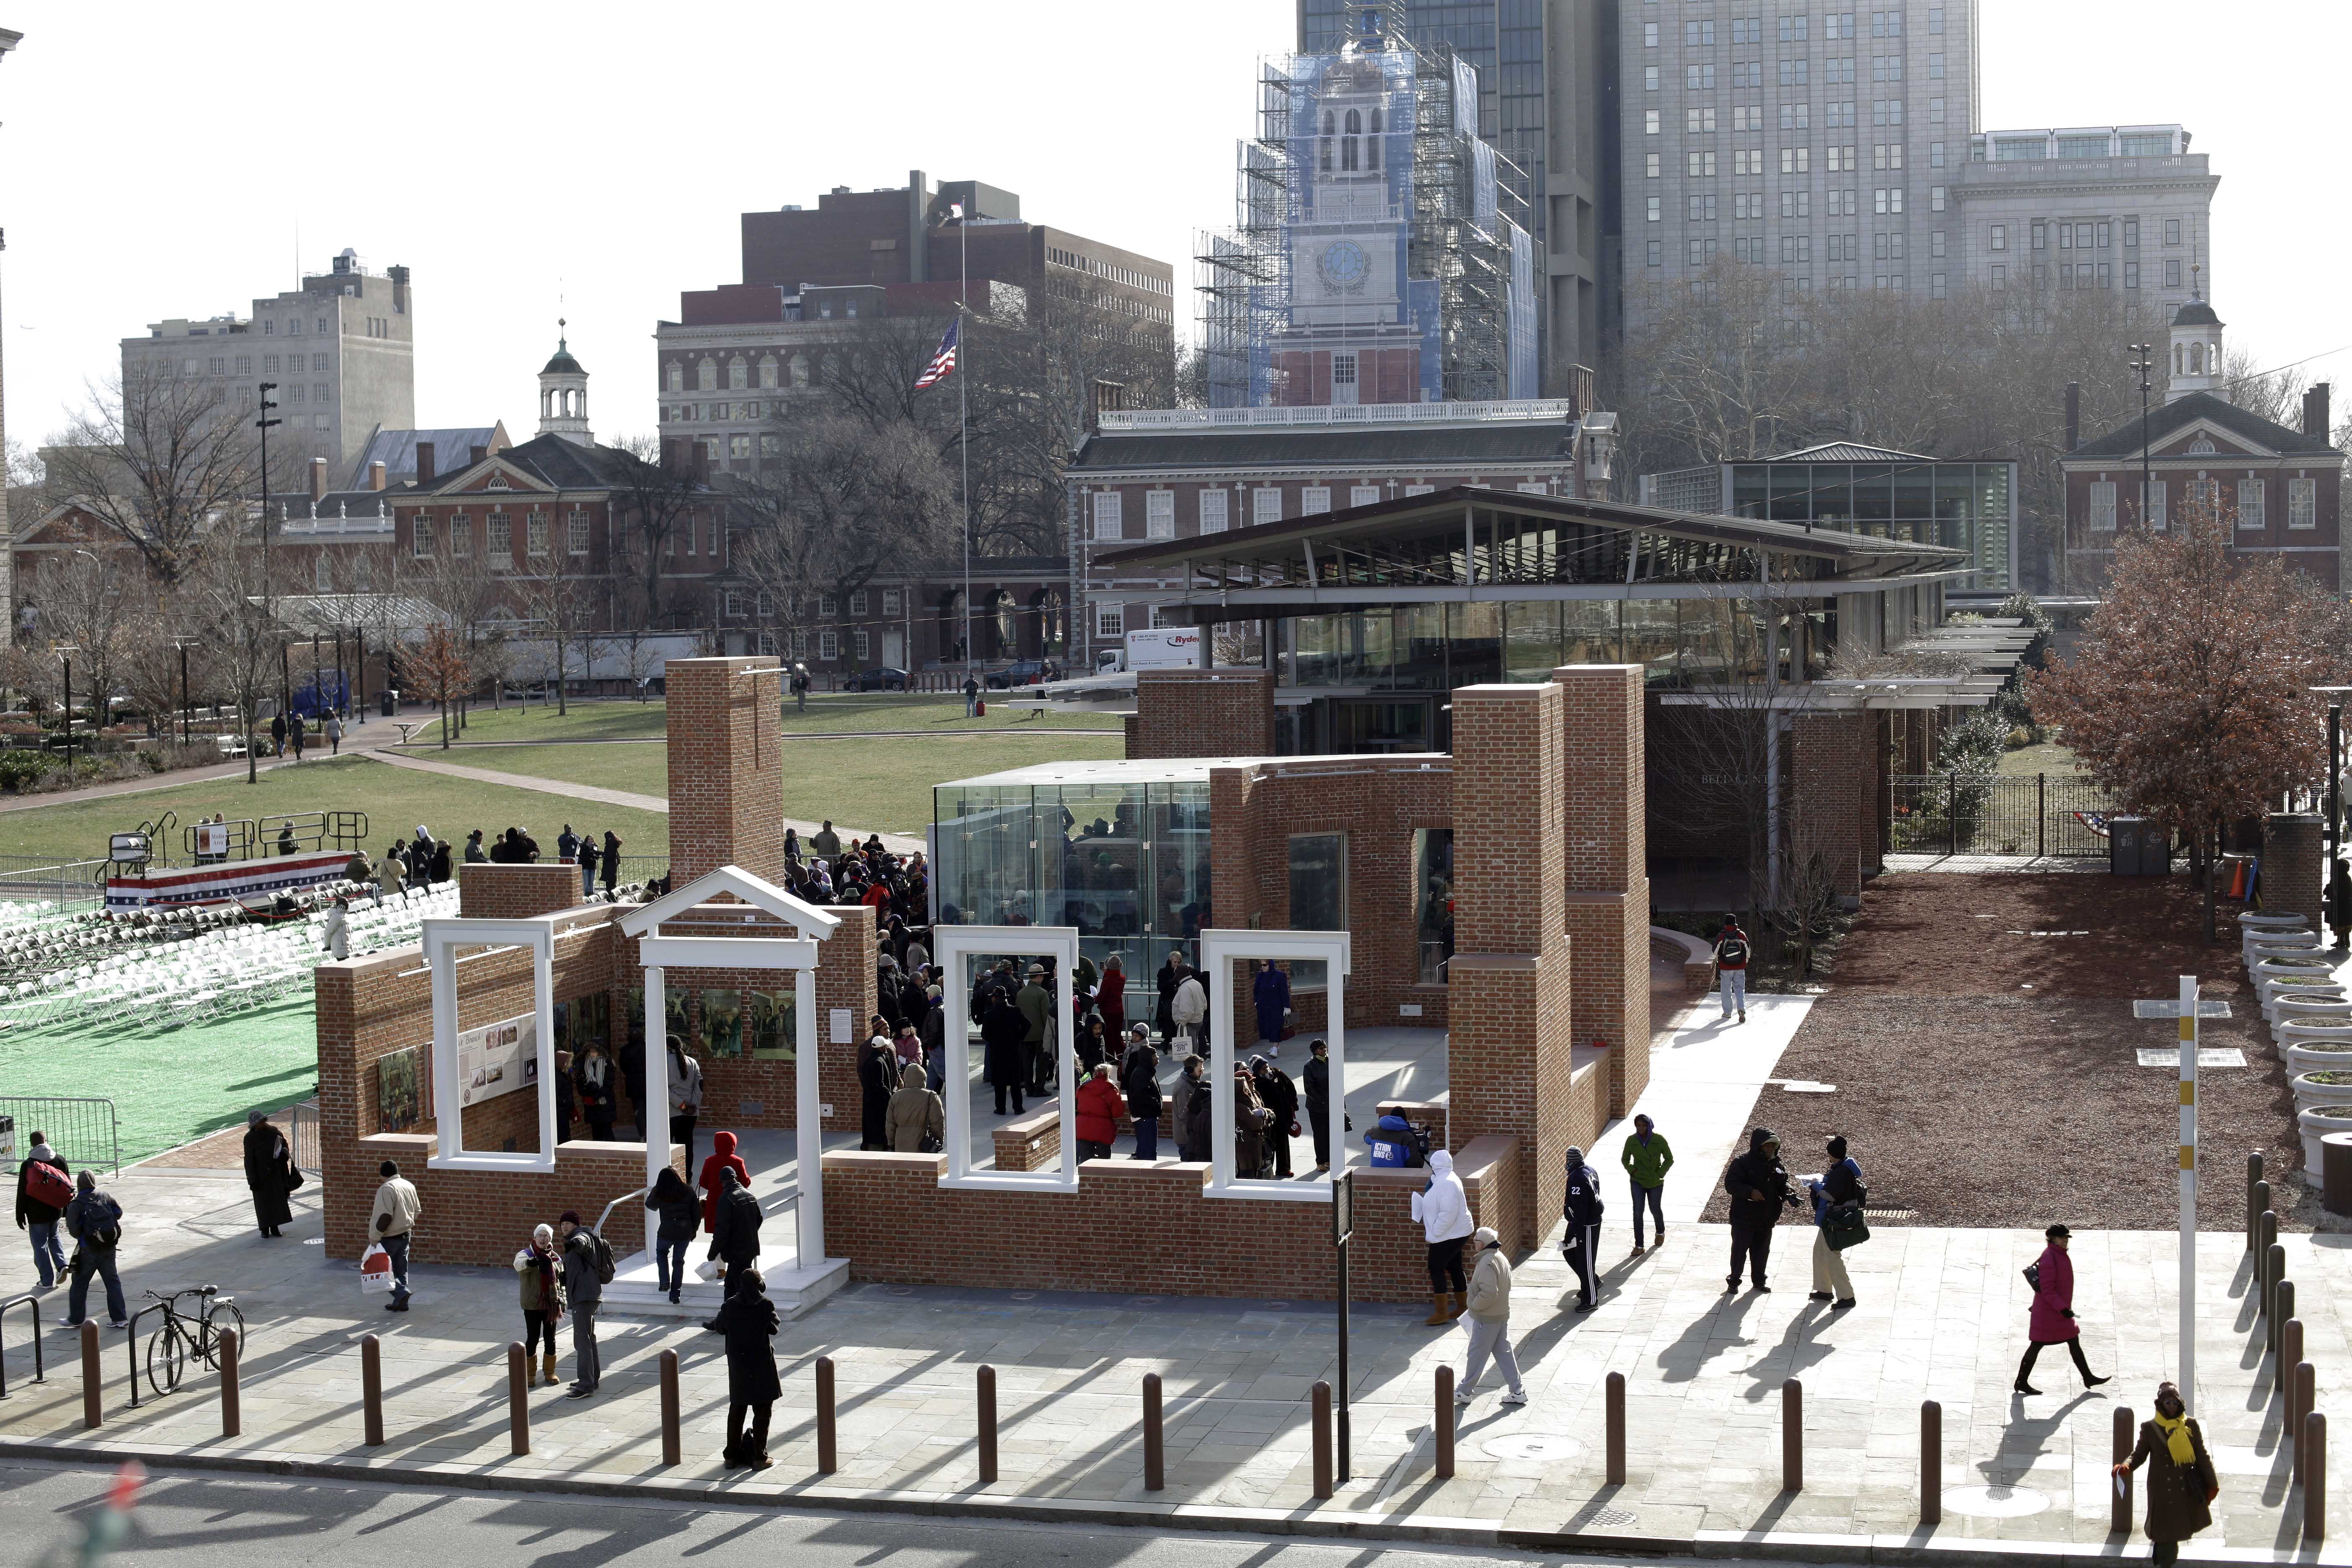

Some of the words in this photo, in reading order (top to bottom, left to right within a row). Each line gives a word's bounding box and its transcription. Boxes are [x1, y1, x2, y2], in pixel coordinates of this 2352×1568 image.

[1702, 774, 1730, 784] BELL
[1735, 774, 1787, 784] CENTR
[1374, 1142, 1391, 1152] ACTION
[1571, 1186, 1581, 1195] 22
